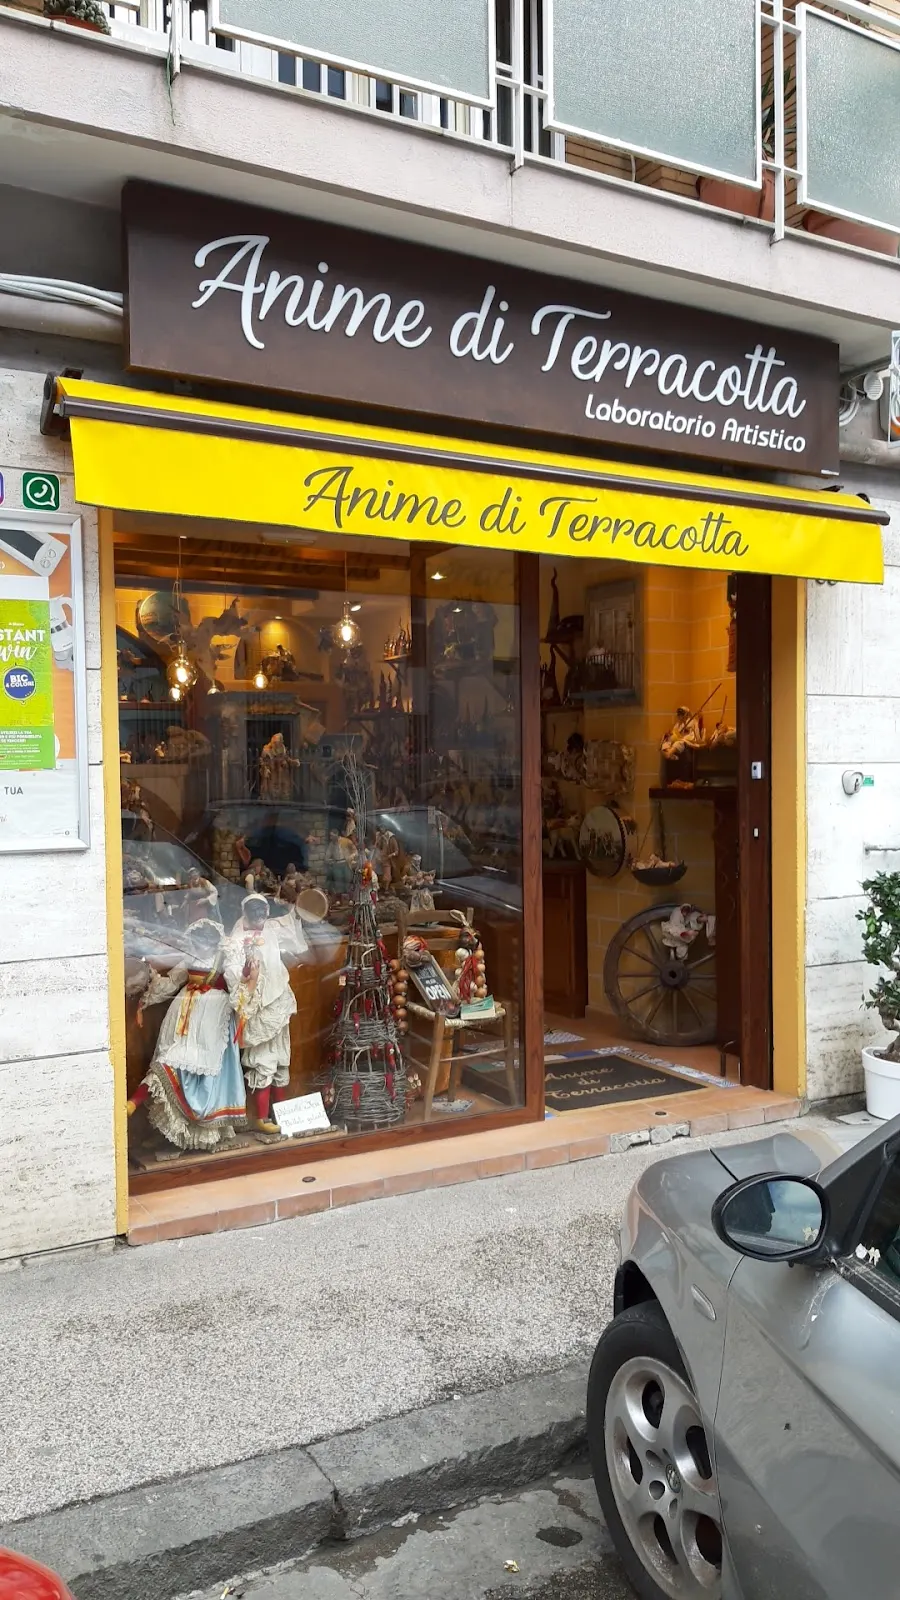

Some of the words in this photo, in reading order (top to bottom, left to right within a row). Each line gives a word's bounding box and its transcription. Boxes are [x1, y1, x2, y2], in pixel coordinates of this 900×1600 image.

[192, 236, 432, 349] Anime
[450, 286, 514, 364] di
[531, 305, 806, 418] Terracotta
[585, 394, 716, 439] Laboratorio
[721, 417, 806, 453] Artistico
[304, 467, 467, 529] Anime
[480, 488, 526, 535] di
[539, 497, 748, 556] Terracotta
[4, 786, 24, 795] TUA
[425, 983, 452, 1001] OPEN
[544, 1067, 614, 1082] Anime
[578, 1076, 601, 1086] di
